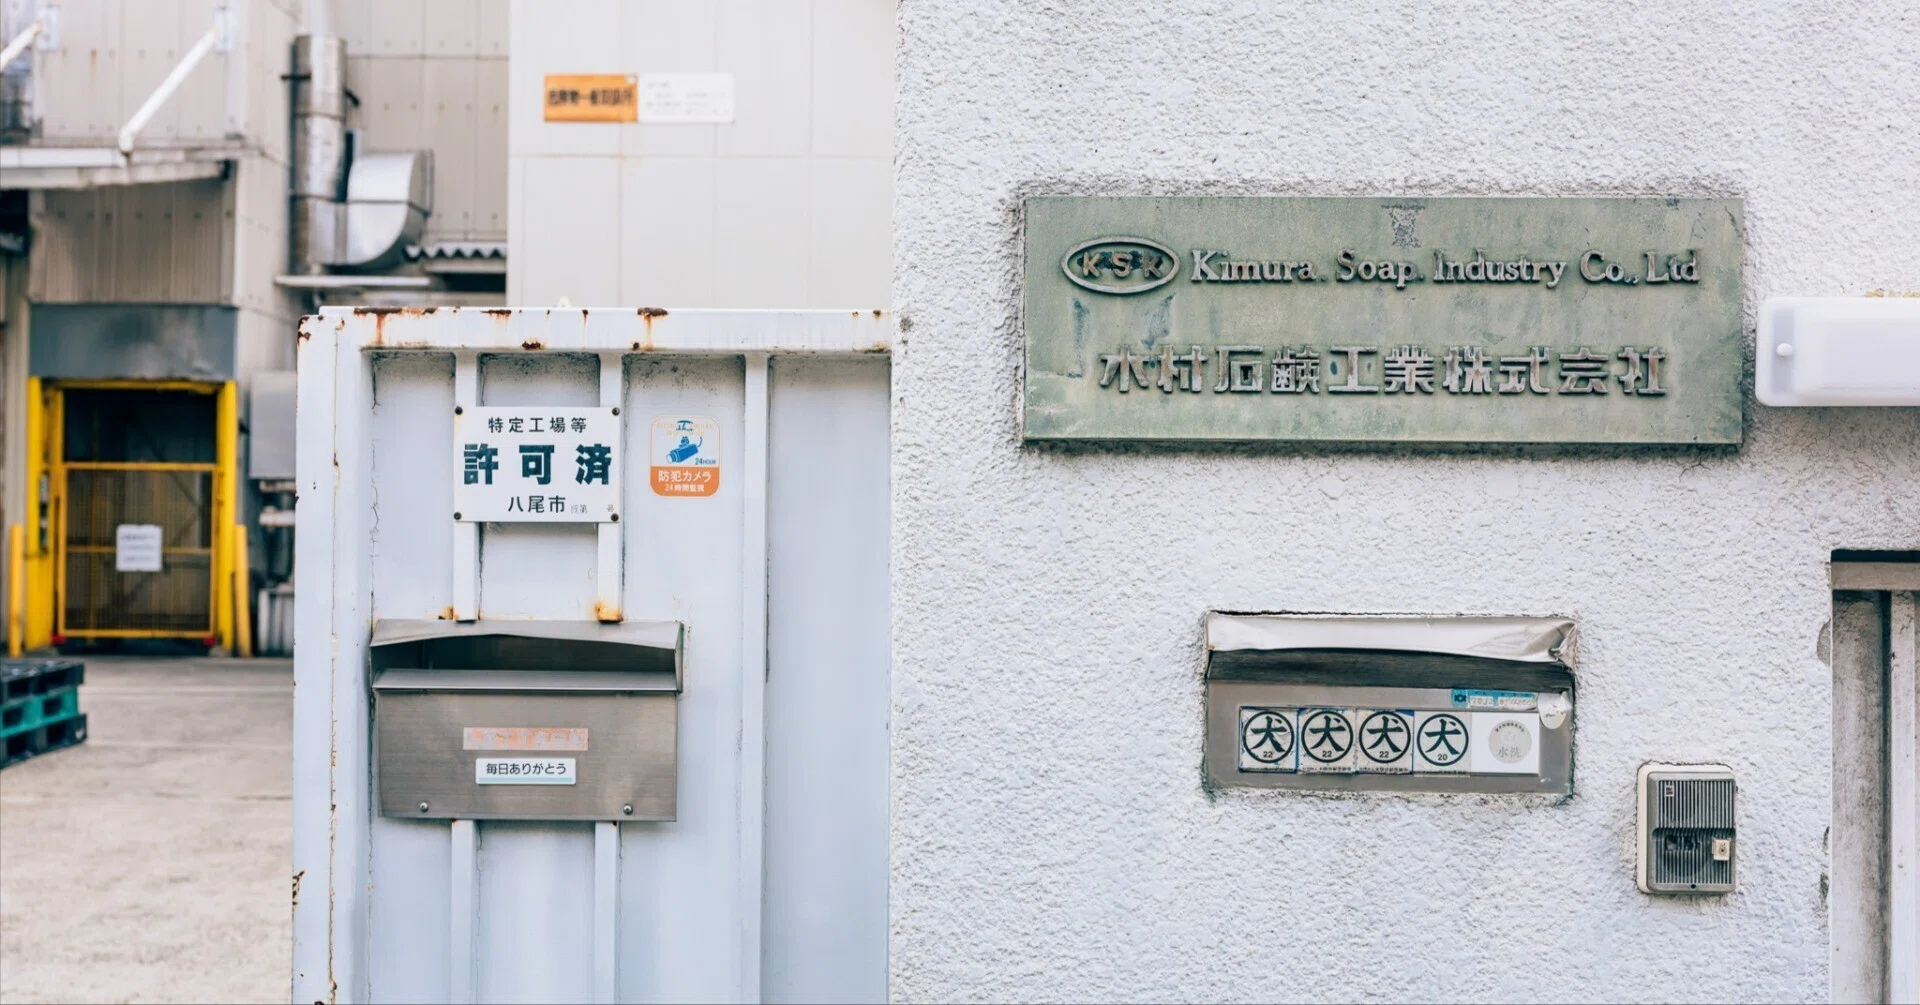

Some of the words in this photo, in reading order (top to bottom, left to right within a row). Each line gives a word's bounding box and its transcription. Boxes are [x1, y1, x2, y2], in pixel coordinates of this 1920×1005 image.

[1433, 249, 1568, 289] Industry
[1099, 345, 1667, 395] 木村石鹸工業株式会社
[488, 416, 587, 434] 特定工場等
[463, 443, 613, 486] 許可済
[658, 470, 712, 483] 防犯カメラ
[507, 495, 566, 513] 八尾市
[1250, 715, 1288, 752] 犬
[1308, 715, 1347, 752] 犬
[1366, 715, 1404, 752] 犬
[1424, 718, 1462, 755] 犬
[486, 763, 567, 775] 毎日ありがとう
[1437, 753, 1448, 761] 20
